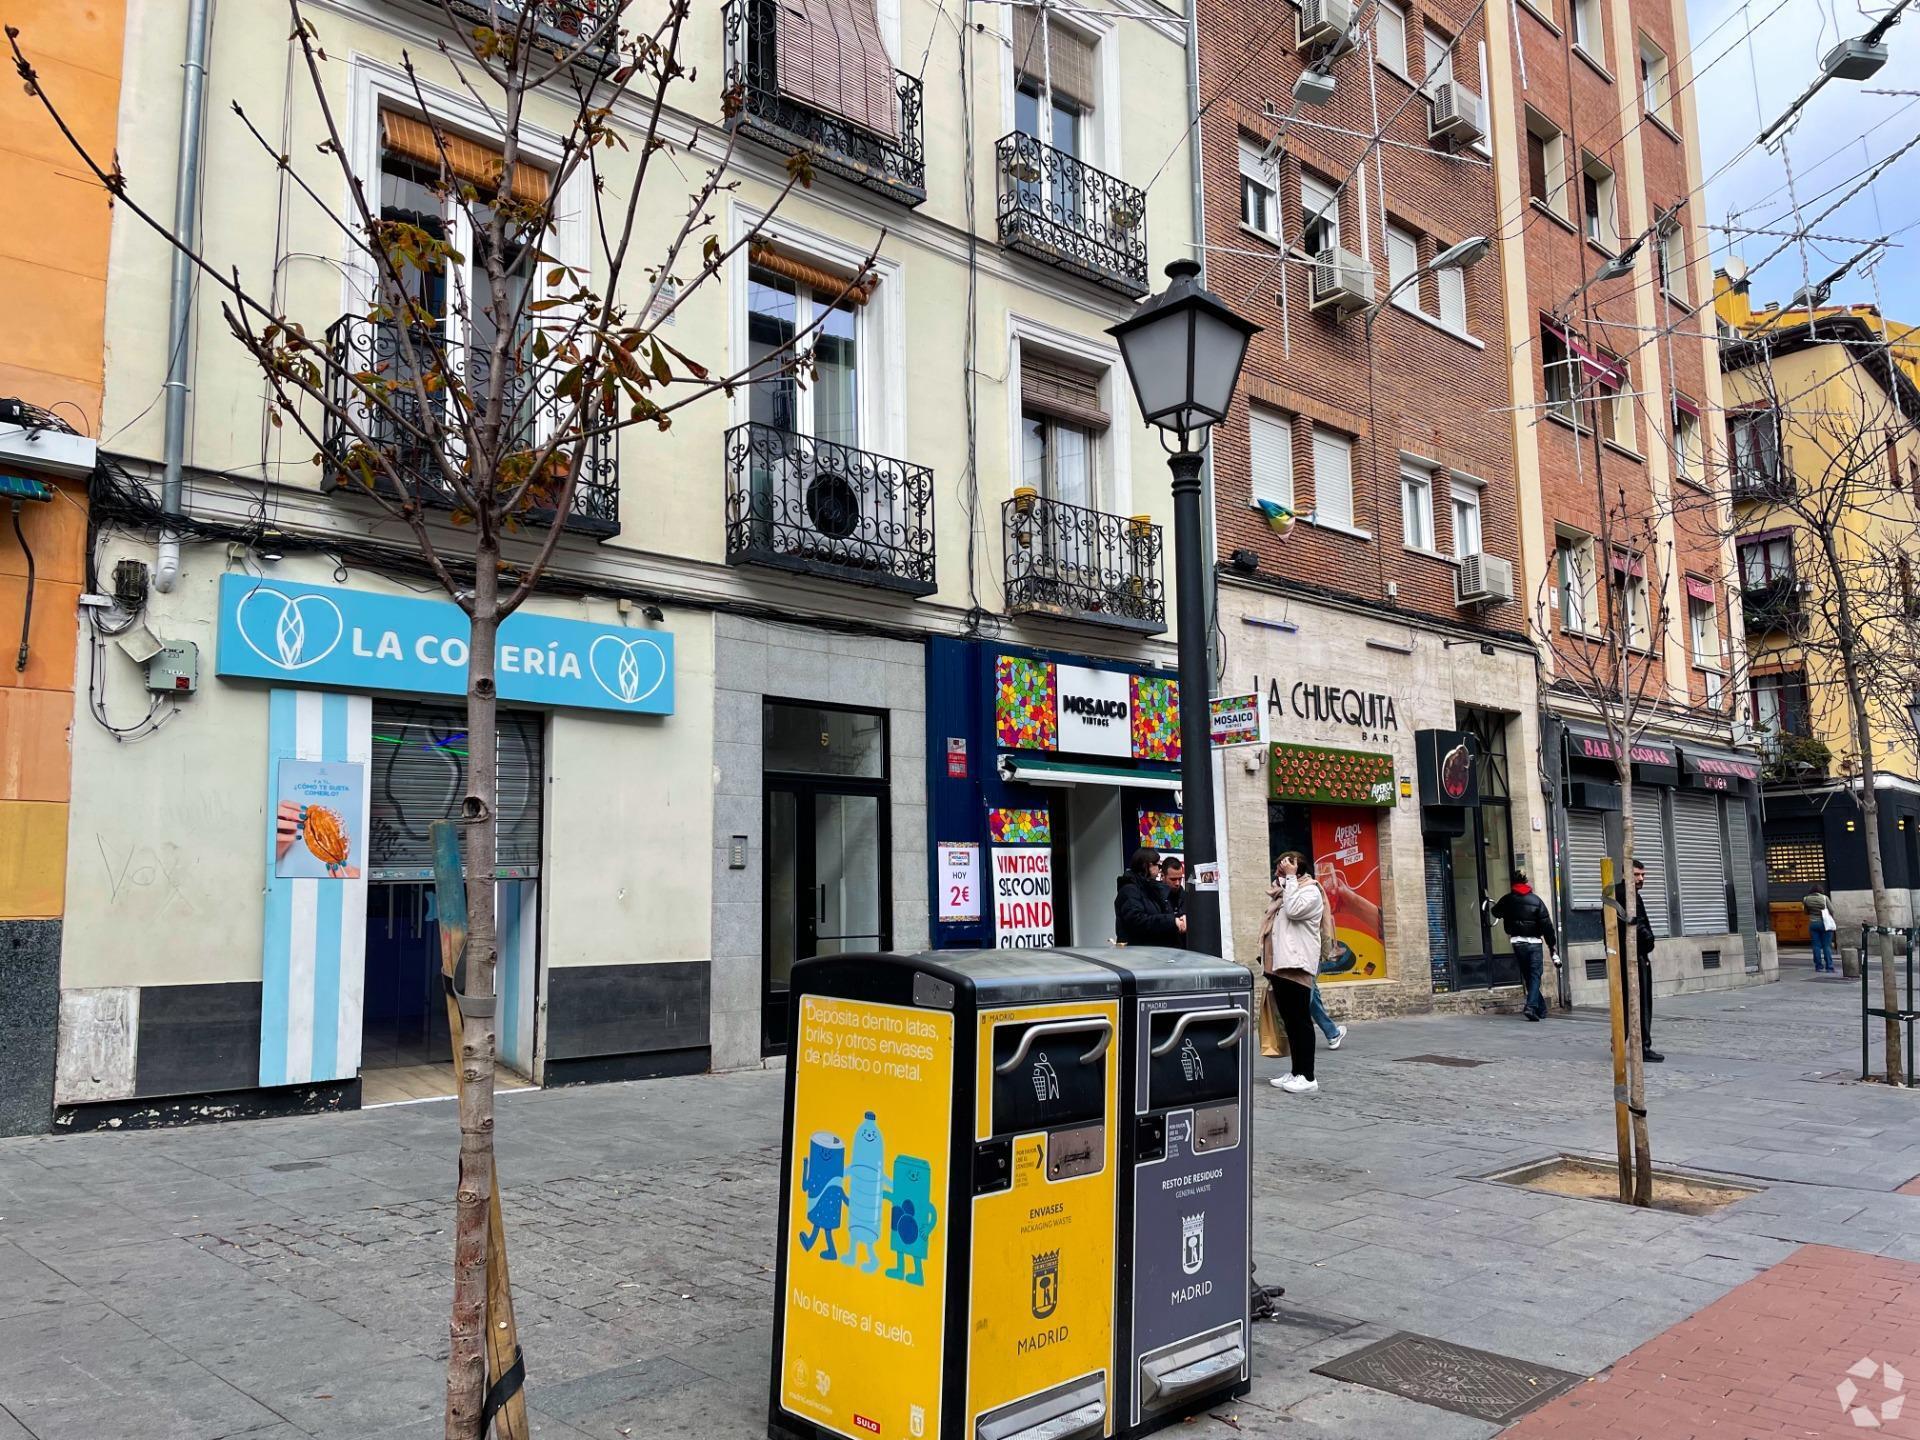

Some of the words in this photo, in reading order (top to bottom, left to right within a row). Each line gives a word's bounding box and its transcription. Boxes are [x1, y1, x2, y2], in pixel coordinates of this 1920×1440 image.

[352, 627, 403, 661] LA
[415, 635, 582, 680] COERÍA
[1063, 695, 1127, 720] MOSAICO
[1291, 681, 1398, 731] CHUEQUITA
[1214, 711, 1253, 726] MOSAICO
[821, 732, 829, 746] 5
[1362, 732, 1389, 743] BAR
[1584, 739, 1611, 758] BAR
[1631, 748, 1670, 765] COPAS
[1371, 782, 1394, 798] APEROL
[1335, 824, 1362, 843] APEROL
[1340, 835, 1358, 850] SPRITZ
[997, 855, 1049, 874] VINTAGE
[1354, 854, 1362, 862] JOY
[950, 886, 969, 906] 2€
[999, 877, 1051, 896] SECOND
[1000, 902, 1053, 929] HAND
[1001, 933, 1054, 949] CLOTHES
[1147, 1001, 1168, 1010] MADRID
[807, 1004, 859, 1028] Deposita
[862, 1012, 902, 1033] dentro
[906, 1018, 939, 1041] latas,
[989, 1012, 1015, 1022] MADRID
[806, 1026, 833, 1046] briks
[836, 1033, 843, 1050] y
[846, 1034, 876, 1051] otros
[880, 1039, 934, 1061] envases
[805, 1047, 820, 1064] de
[822, 1051, 870, 1072] plástico
[873, 1060, 882, 1075] o
[884, 1062, 922, 1082] metal.
[1162, 1177, 1182, 1190] RESTO
[1183, 1175, 1192, 1186] DE
[1193, 1168, 1223, 1184] RESIDUOS
[1030, 1203, 1064, 1220] ENVASES
[1020, 1220, 1052, 1234] PACKAGING
[1053, 1216, 1072, 1227] WASTE
[1171, 1280, 1213, 1306] MADRID
[793, 1288, 811, 1310] No
[813, 1295, 830, 1318] los
[832, 1304, 857, 1328] tires
[860, 1314, 871, 1332] al
[874, 1321, 914, 1347] suelo.
[1017, 1325, 1069, 1356] MADRID
[856, 1417, 877, 1432] SULO
